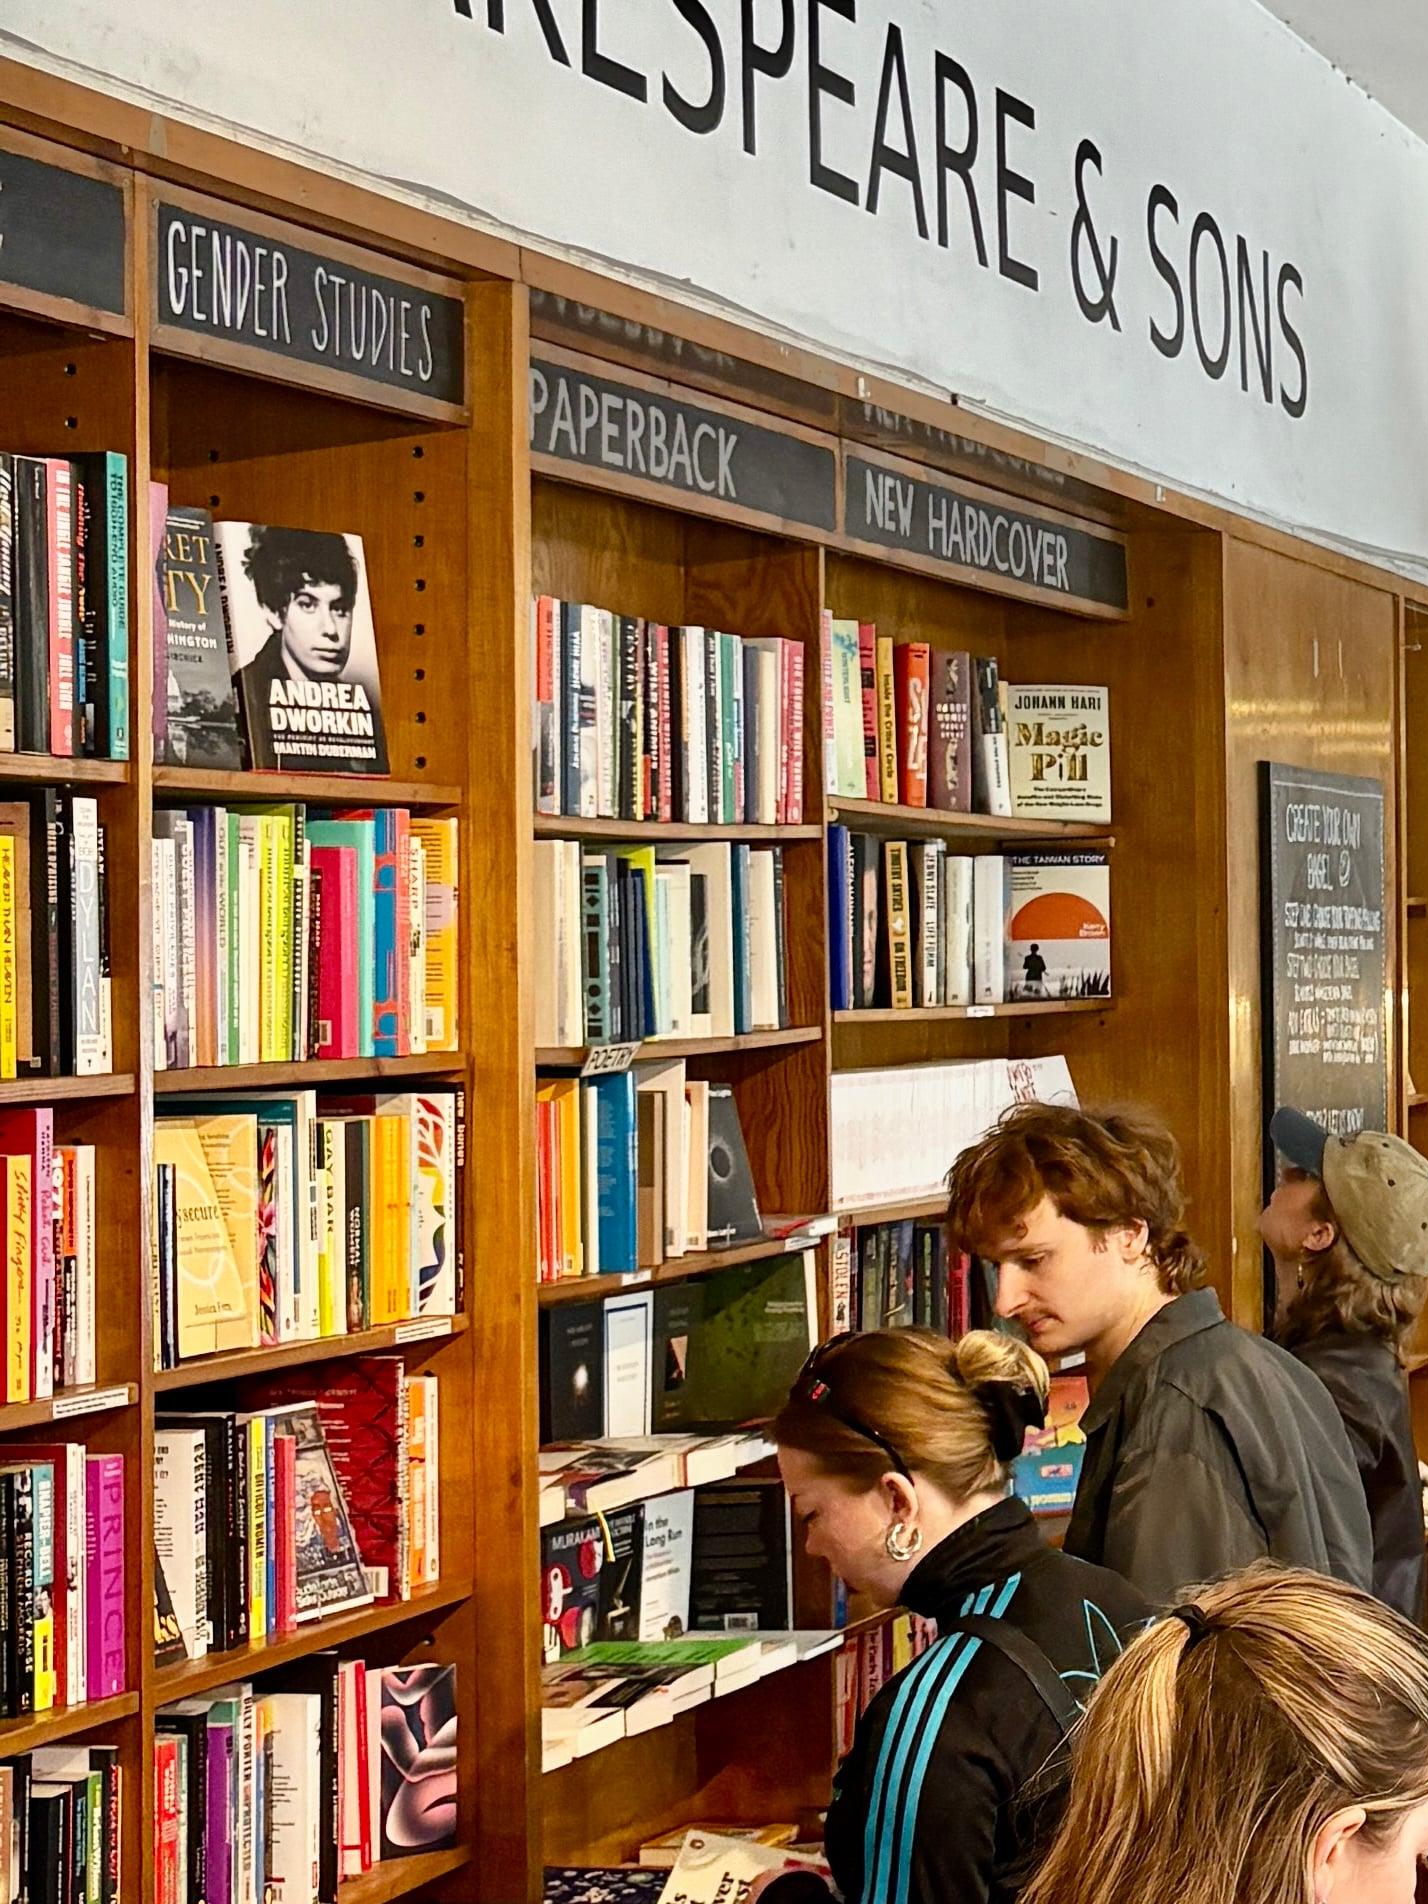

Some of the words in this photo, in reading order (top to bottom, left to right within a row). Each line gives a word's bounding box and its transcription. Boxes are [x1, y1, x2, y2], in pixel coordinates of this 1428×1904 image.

[1071, 138, 1120, 331] &
[1146, 184, 1308, 418] SONS
[168, 223, 290, 347] GENDER
[313, 266, 435, 382] STUDIES
[531, 369, 737, 498] PAPERBACK
[866, 469, 914, 536] NEW
[928, 493, 1070, 591] HARDCOVER
[269, 679, 370, 710] ANDREA
[1014, 695, 1066, 710] JOHANN
[1071, 697, 1101, 710] HARI
[270, 708, 374, 736] DWORKIN
[1014, 722, 1103, 754] Magic
[1031, 753, 1088, 782] Pill
[1286, 803, 1321, 844] CREATE
[1322, 808, 1341, 846] YOUR
[1342, 813, 1360, 849] OWN
[79, 861, 96, 1033] DYLAN
[586, 1044, 636, 1073] POETRY
[103, 1483, 122, 1674] PRINCE
